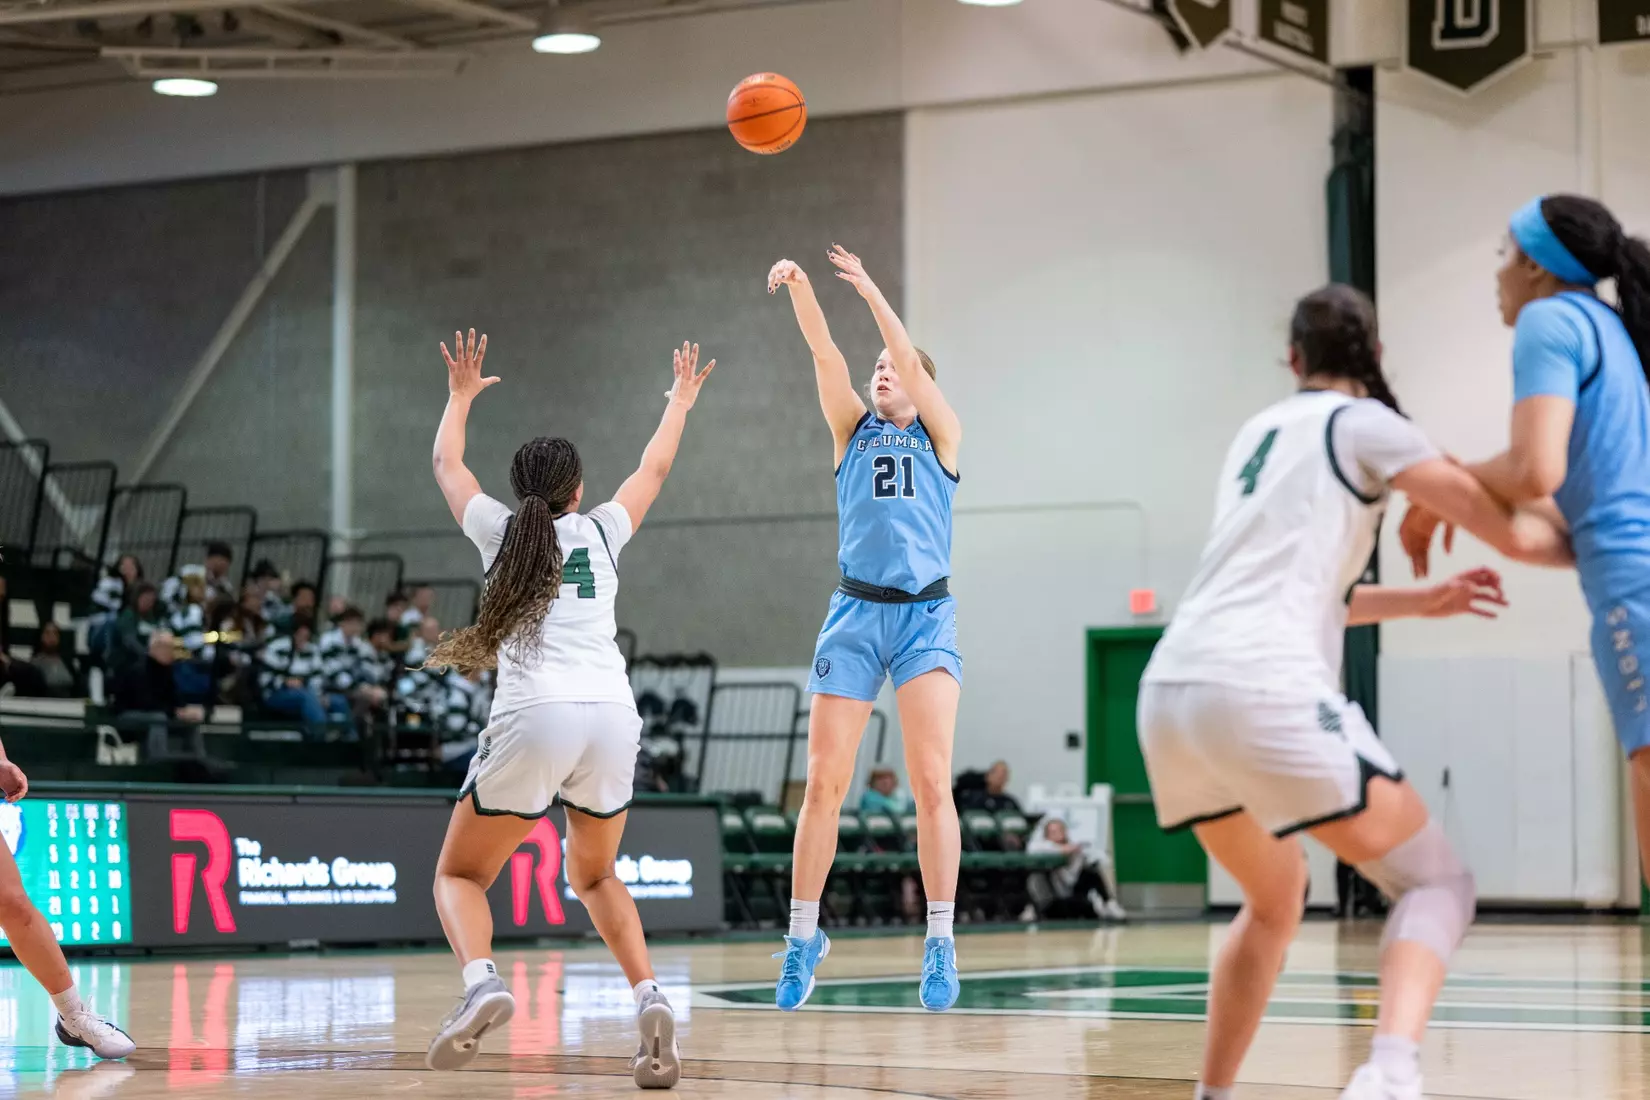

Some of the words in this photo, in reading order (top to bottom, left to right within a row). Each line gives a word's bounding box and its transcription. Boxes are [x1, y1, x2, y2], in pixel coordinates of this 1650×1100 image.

[857, 435, 934, 453] CLUMBA
[1238, 427, 1279, 495] 4
[872, 454, 916, 500] 21
[235, 837, 261, 856] The
[169, 809, 237, 934] R
[238, 856, 330, 887] Richards
[331, 856, 397, 890] Group
